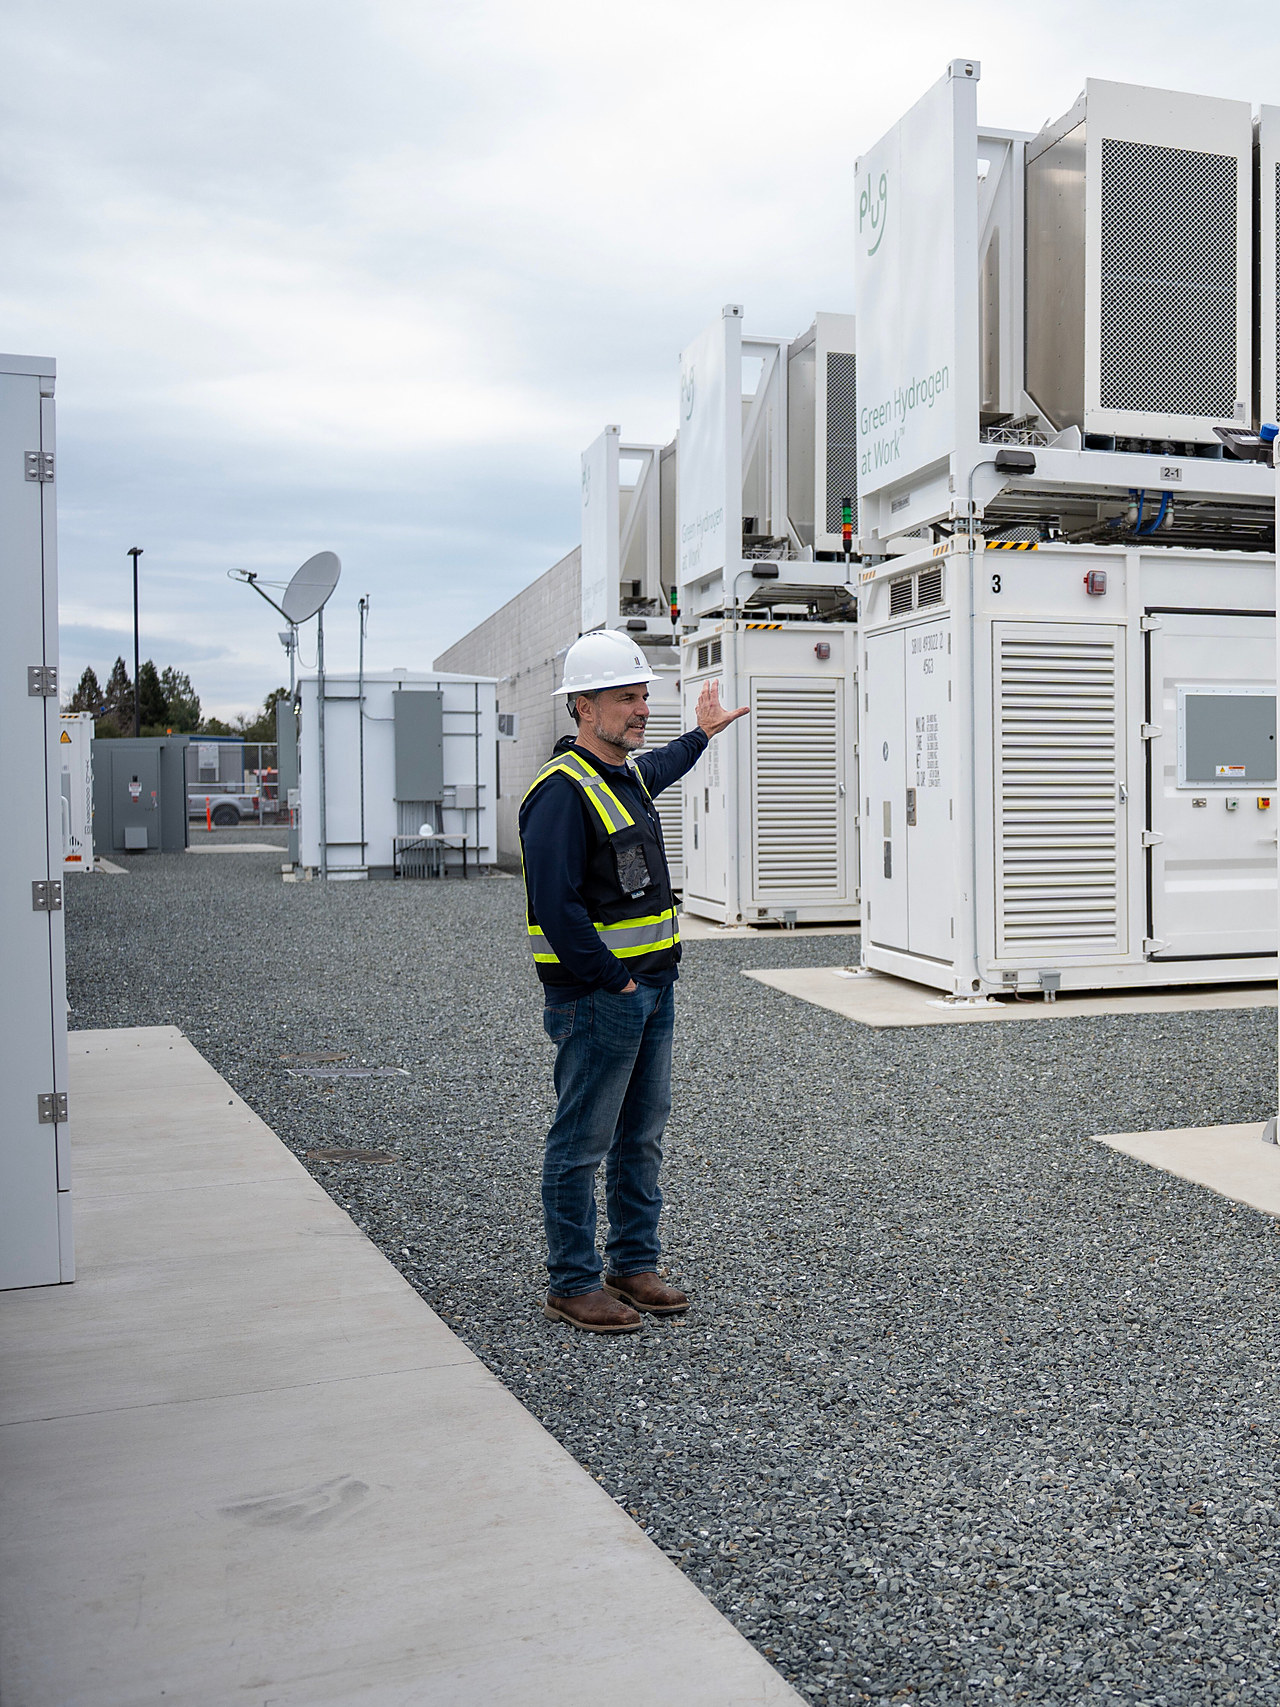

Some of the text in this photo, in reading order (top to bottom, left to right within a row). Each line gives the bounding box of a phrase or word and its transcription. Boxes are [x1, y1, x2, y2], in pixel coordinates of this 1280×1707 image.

[860, 172, 887, 256] plug
[860, 365, 949, 436] Green Hydrogen
[861, 447, 871, 476] at
[1164, 467, 1180, 478] 2-1
[992, 574, 1001, 594] 3
